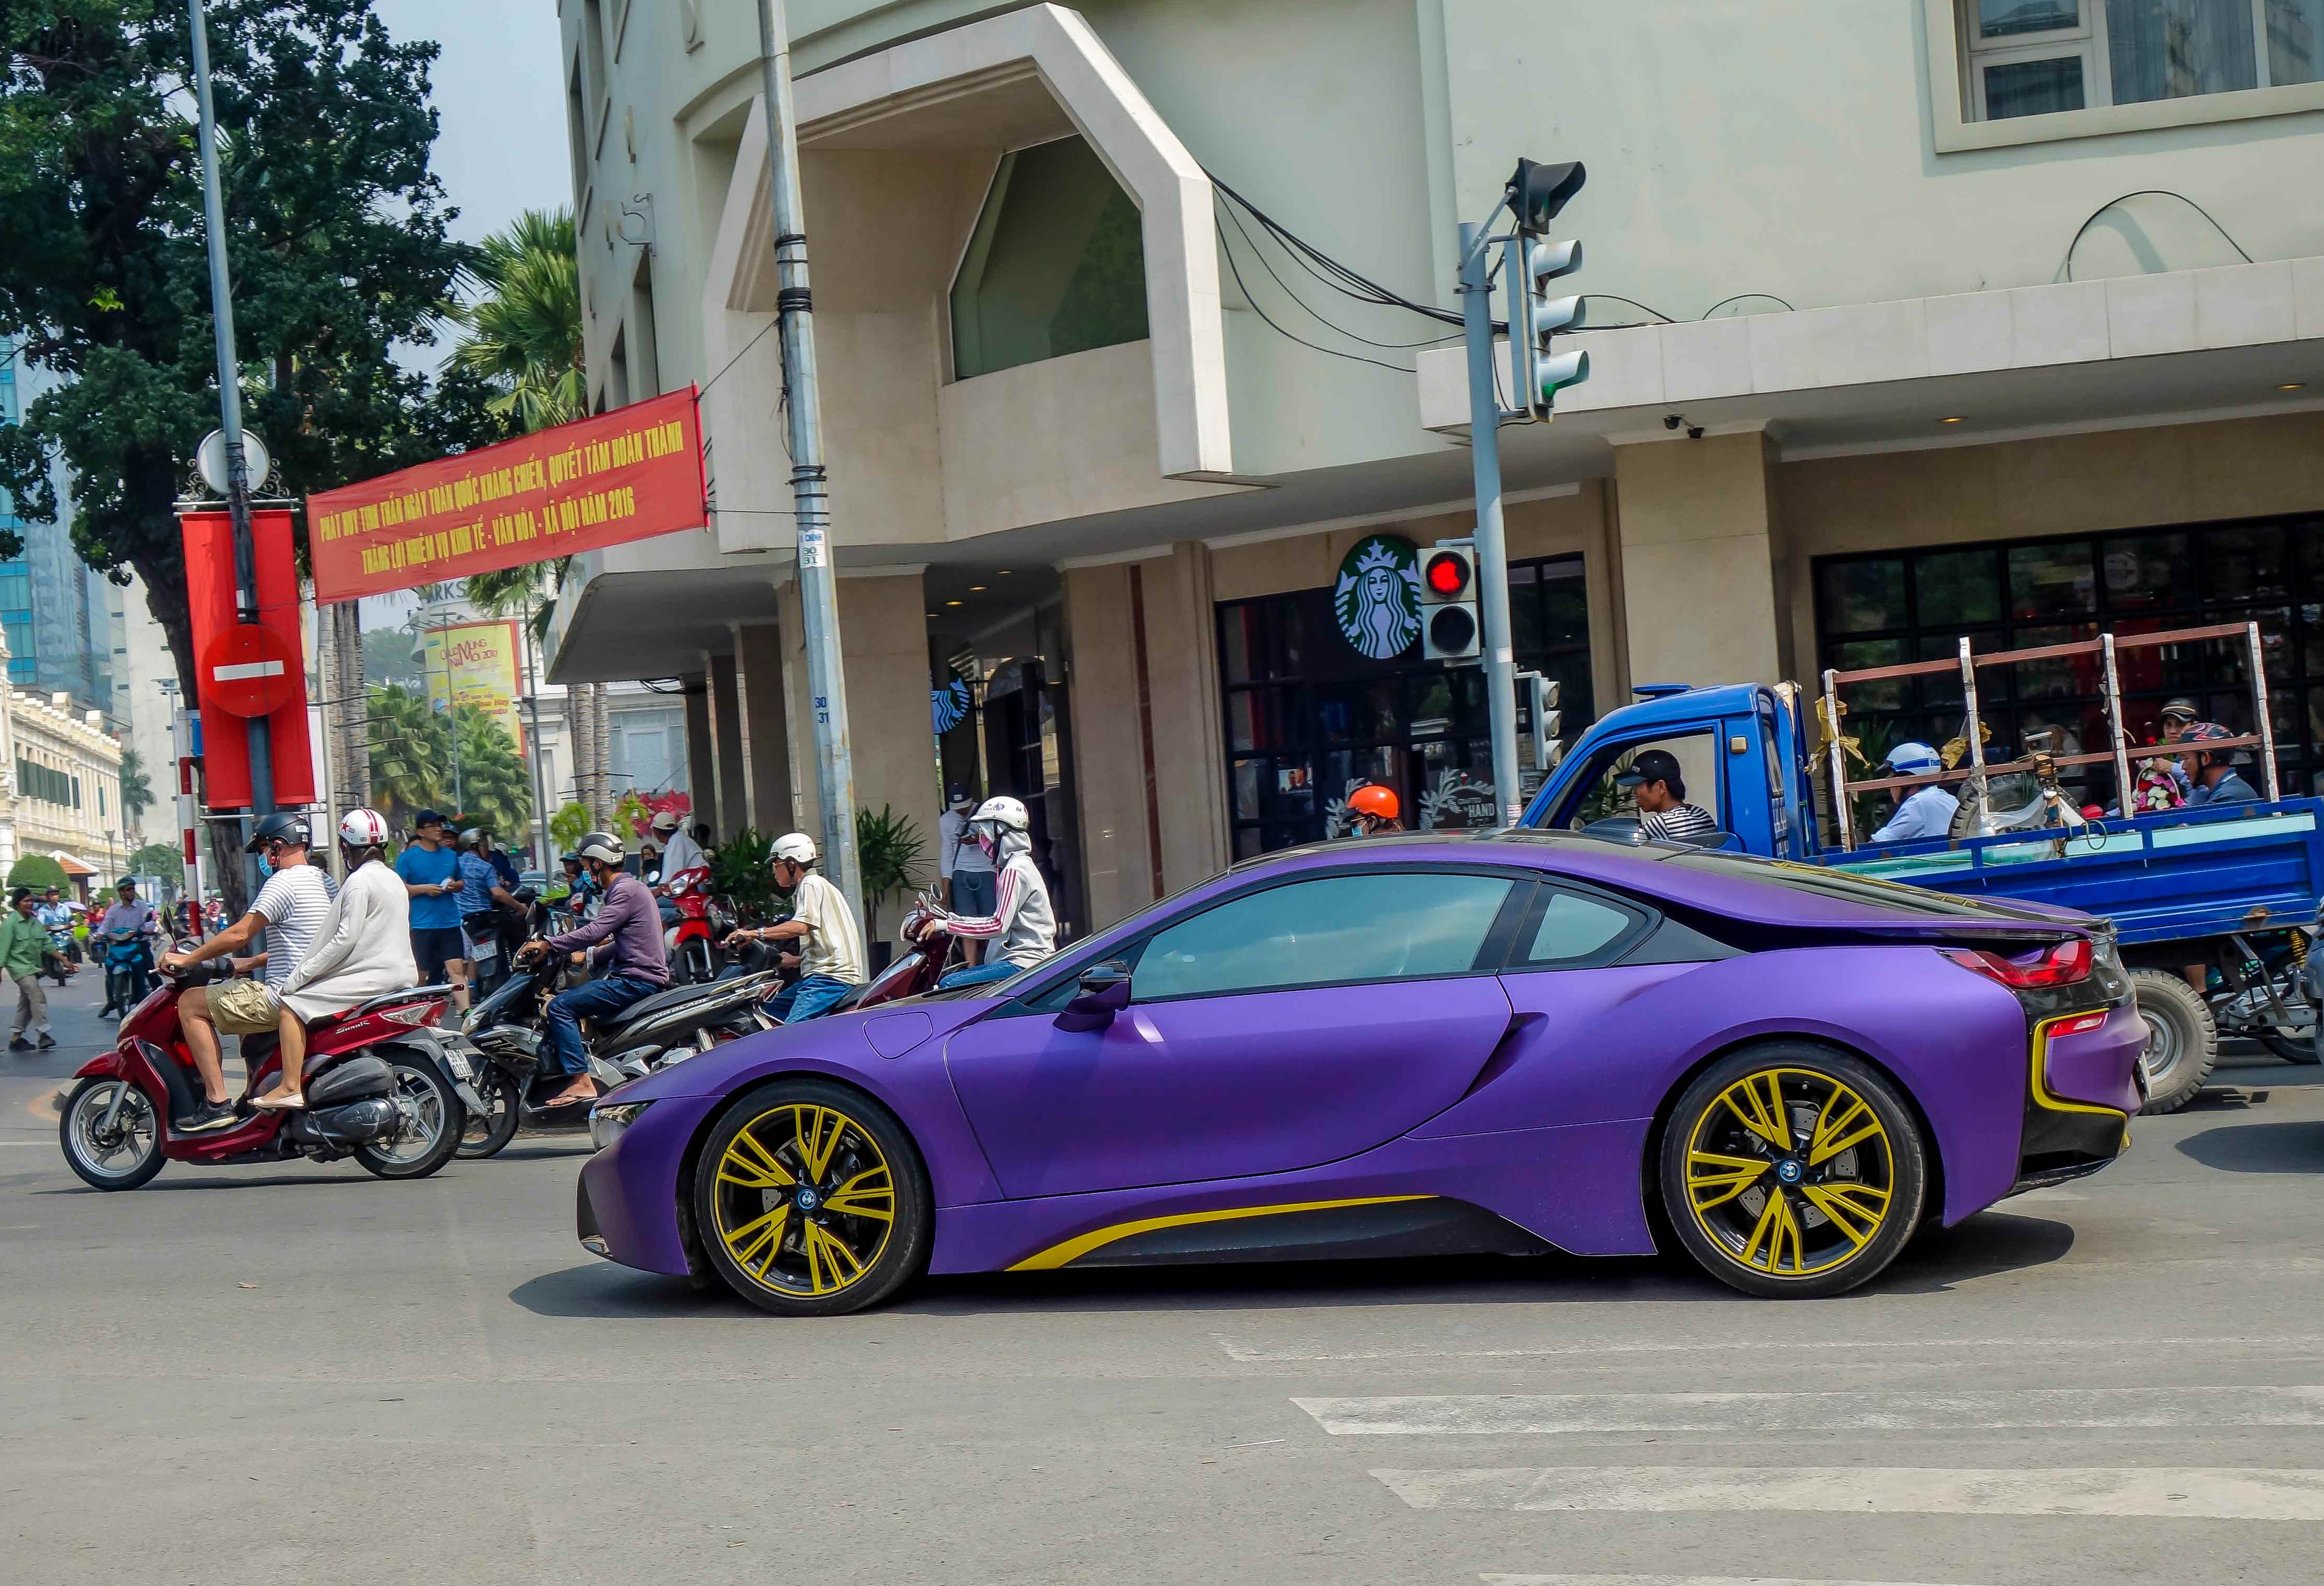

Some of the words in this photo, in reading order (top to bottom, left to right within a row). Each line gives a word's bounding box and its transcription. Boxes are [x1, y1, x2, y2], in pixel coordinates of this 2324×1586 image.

[548, 441, 582, 488] QUYẾT
[584, 438, 610, 475] TÂM
[611, 428, 644, 468] HOÀN
[644, 419, 684, 459] THÀNH
[472, 514, 486, 550] TẾ
[542, 499, 560, 535] XÃ
[579, 490, 607, 526] NĂM
[608, 485, 635, 520] 2016
[803, 547, 816, 555] 30
[815, 696, 826, 708] 30
[818, 712, 829, 724] 31
[1468, 803, 1495, 817] HAND
